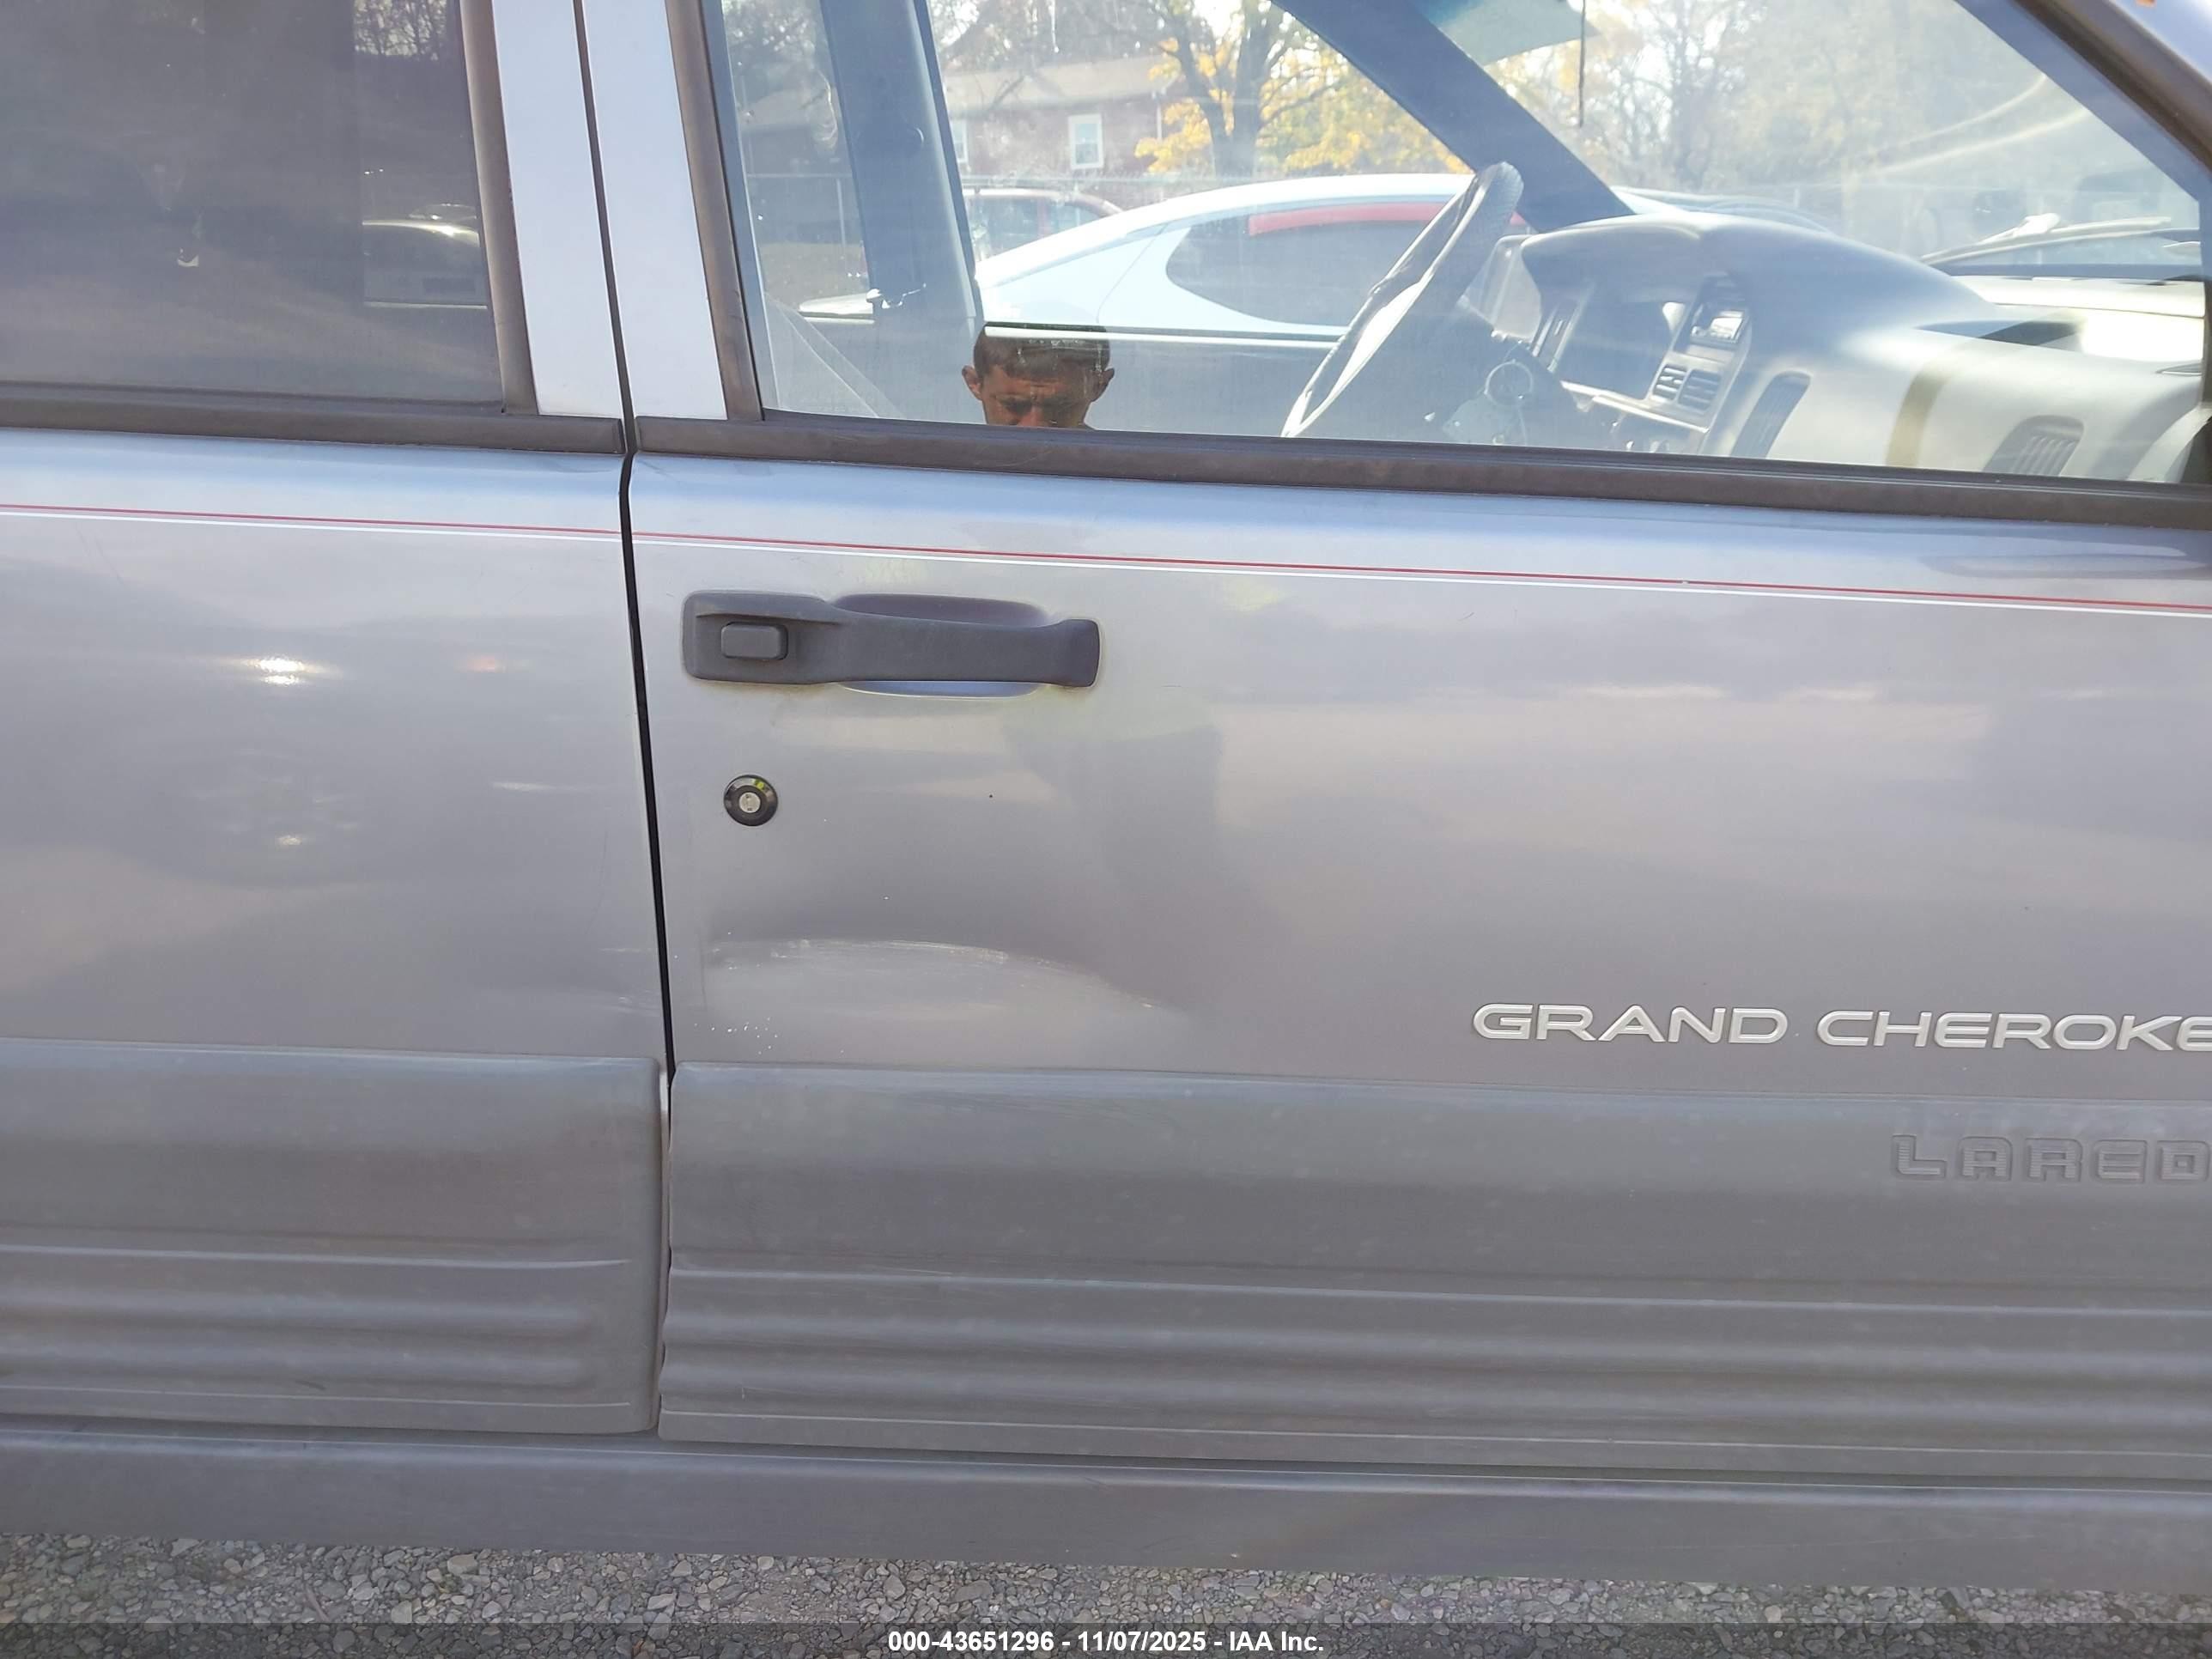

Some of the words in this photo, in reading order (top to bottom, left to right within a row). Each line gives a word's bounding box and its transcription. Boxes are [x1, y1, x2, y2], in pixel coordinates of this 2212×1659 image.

[1472, 1003, 1789, 1045] GRAND
[1816, 1009, 2212, 1052] CHEROKE
[1893, 1134, 2210, 1184] LARED
